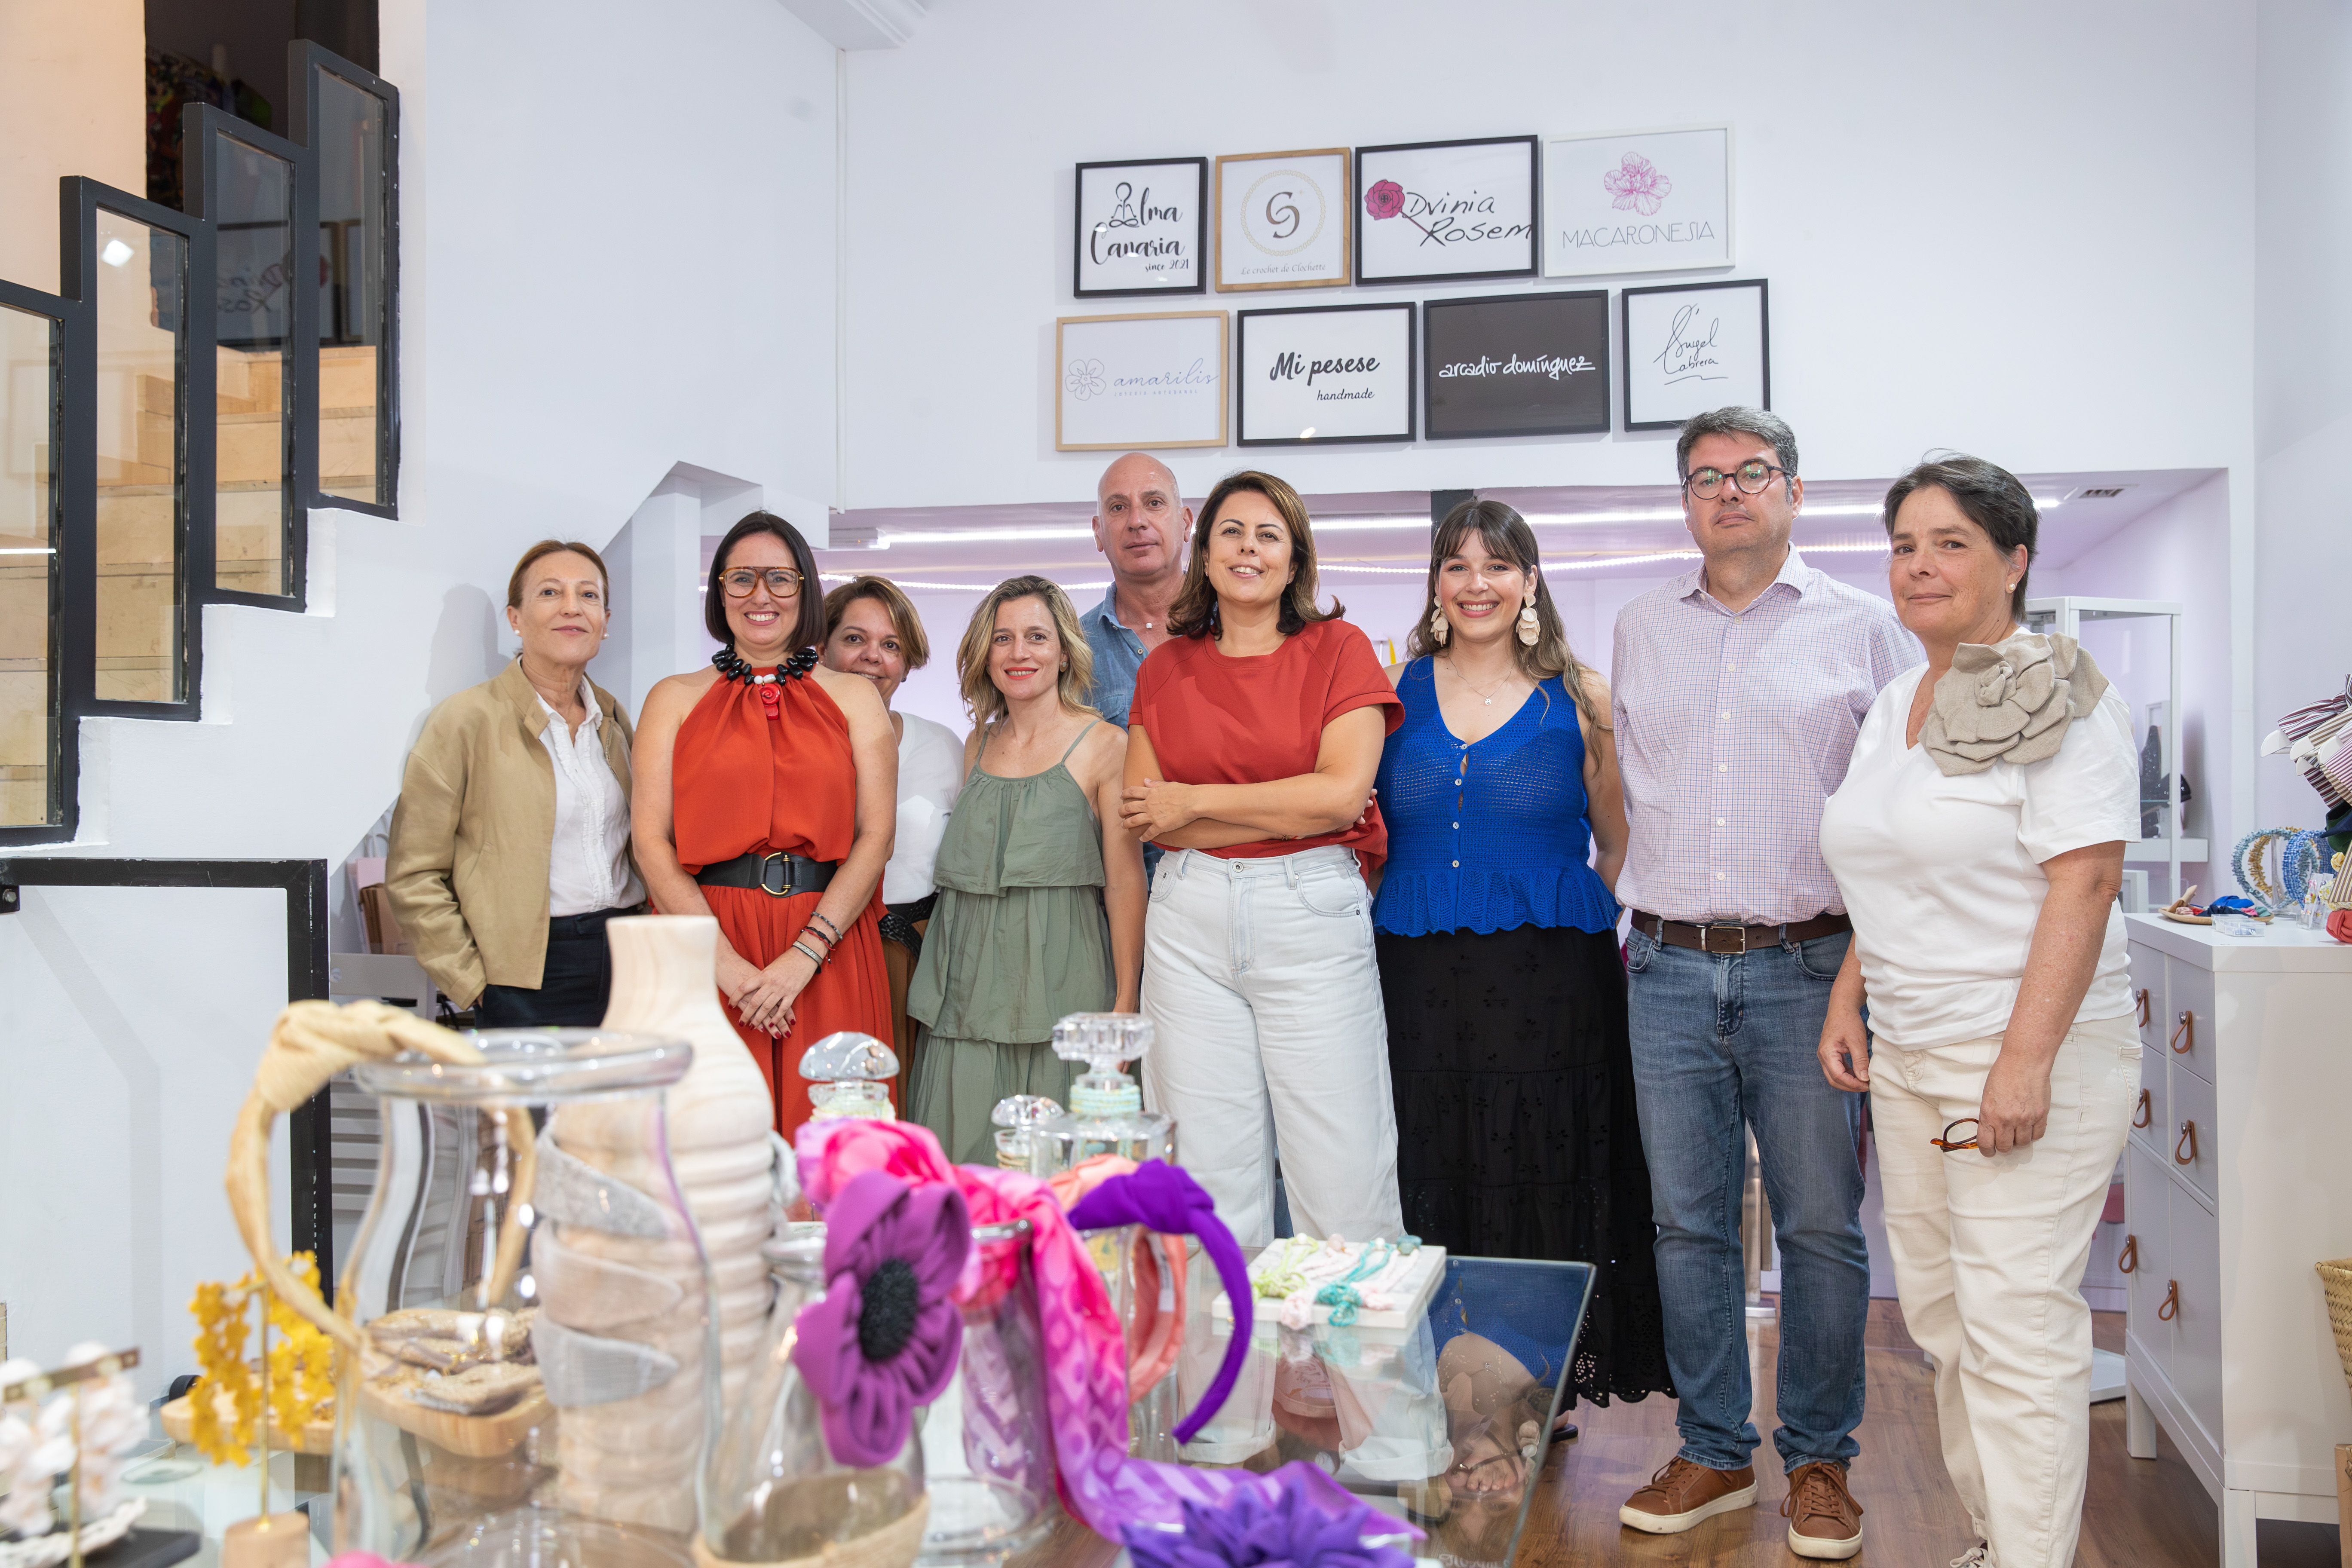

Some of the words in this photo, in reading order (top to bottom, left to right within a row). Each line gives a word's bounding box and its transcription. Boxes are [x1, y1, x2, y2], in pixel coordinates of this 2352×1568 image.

[1090, 222, 1185, 265] Canaria
[1563, 221, 1715, 249] MACARONESIA
[1145, 263, 1165, 273] since
[1169, 258, 1188, 270] 2021
[1252, 264, 1279, 274] crochet
[1281, 263, 1289, 273] de
[1292, 262, 1326, 272] Clochette
[1114, 358, 1219, 387] amarilis
[1270, 352, 1305, 381] Mi
[1307, 357, 1380, 386] pesese
[1439, 355, 1502, 377] arcadio
[1664, 352, 1718, 374] Cabrera
[1317, 388, 1375, 401] handmade
